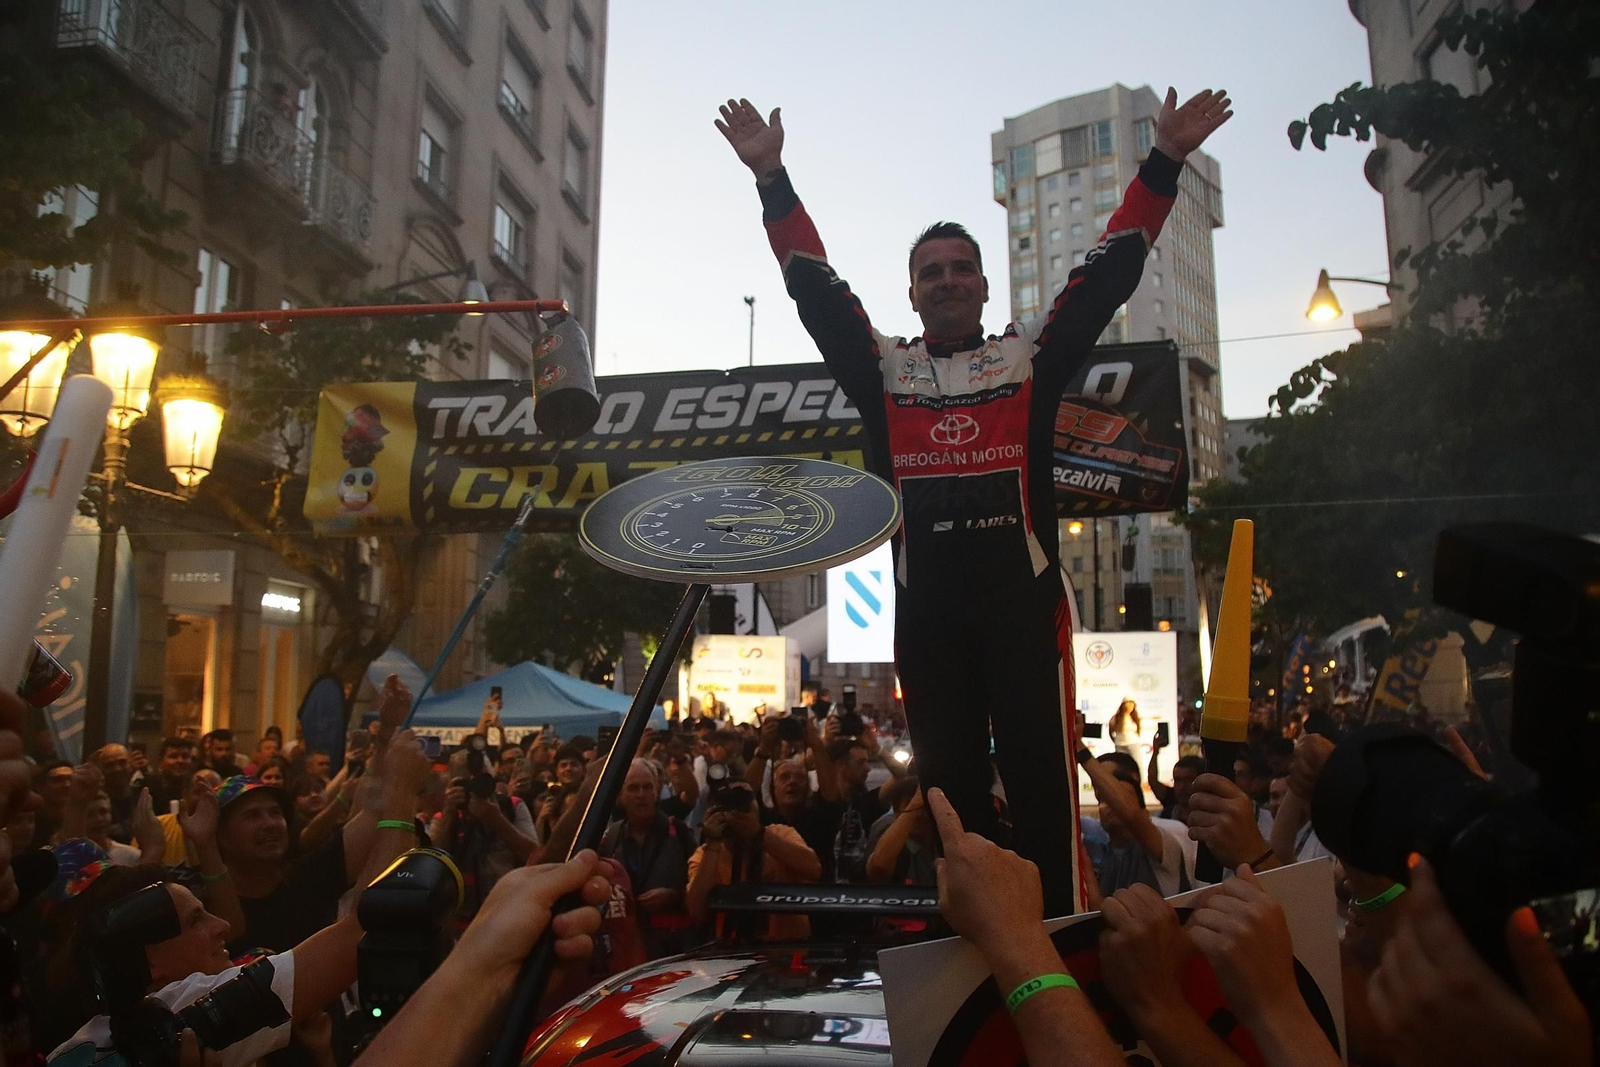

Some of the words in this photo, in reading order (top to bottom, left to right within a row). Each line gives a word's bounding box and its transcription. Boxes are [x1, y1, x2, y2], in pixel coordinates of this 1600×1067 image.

[916, 397, 944, 409] TOYO
[428, 391, 646, 438] TRAO
[972, 444, 1024, 463] MOTOR
[673, 464, 799, 483] GO!!
[767, 475, 866, 489] GO!!
[755, 894, 941, 906] grupobreoga
